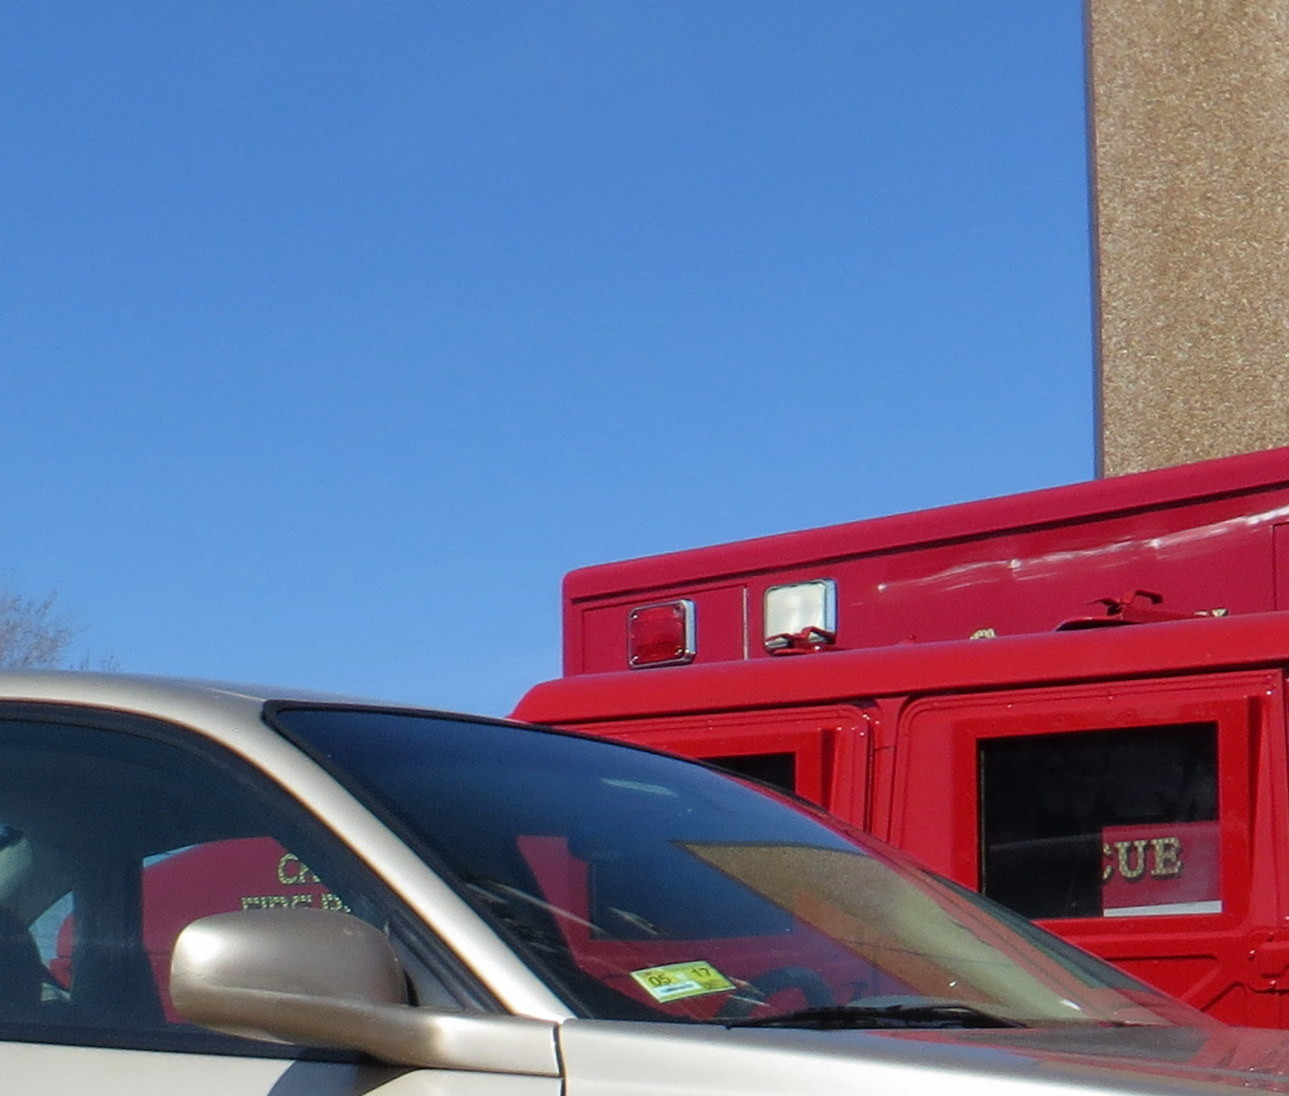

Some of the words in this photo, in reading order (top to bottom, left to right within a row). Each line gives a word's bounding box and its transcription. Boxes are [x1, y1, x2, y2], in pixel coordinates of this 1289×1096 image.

[1103, 838, 1180, 879] UE
[648, 974, 672, 987] 05
[692, 967, 711, 978] 17
